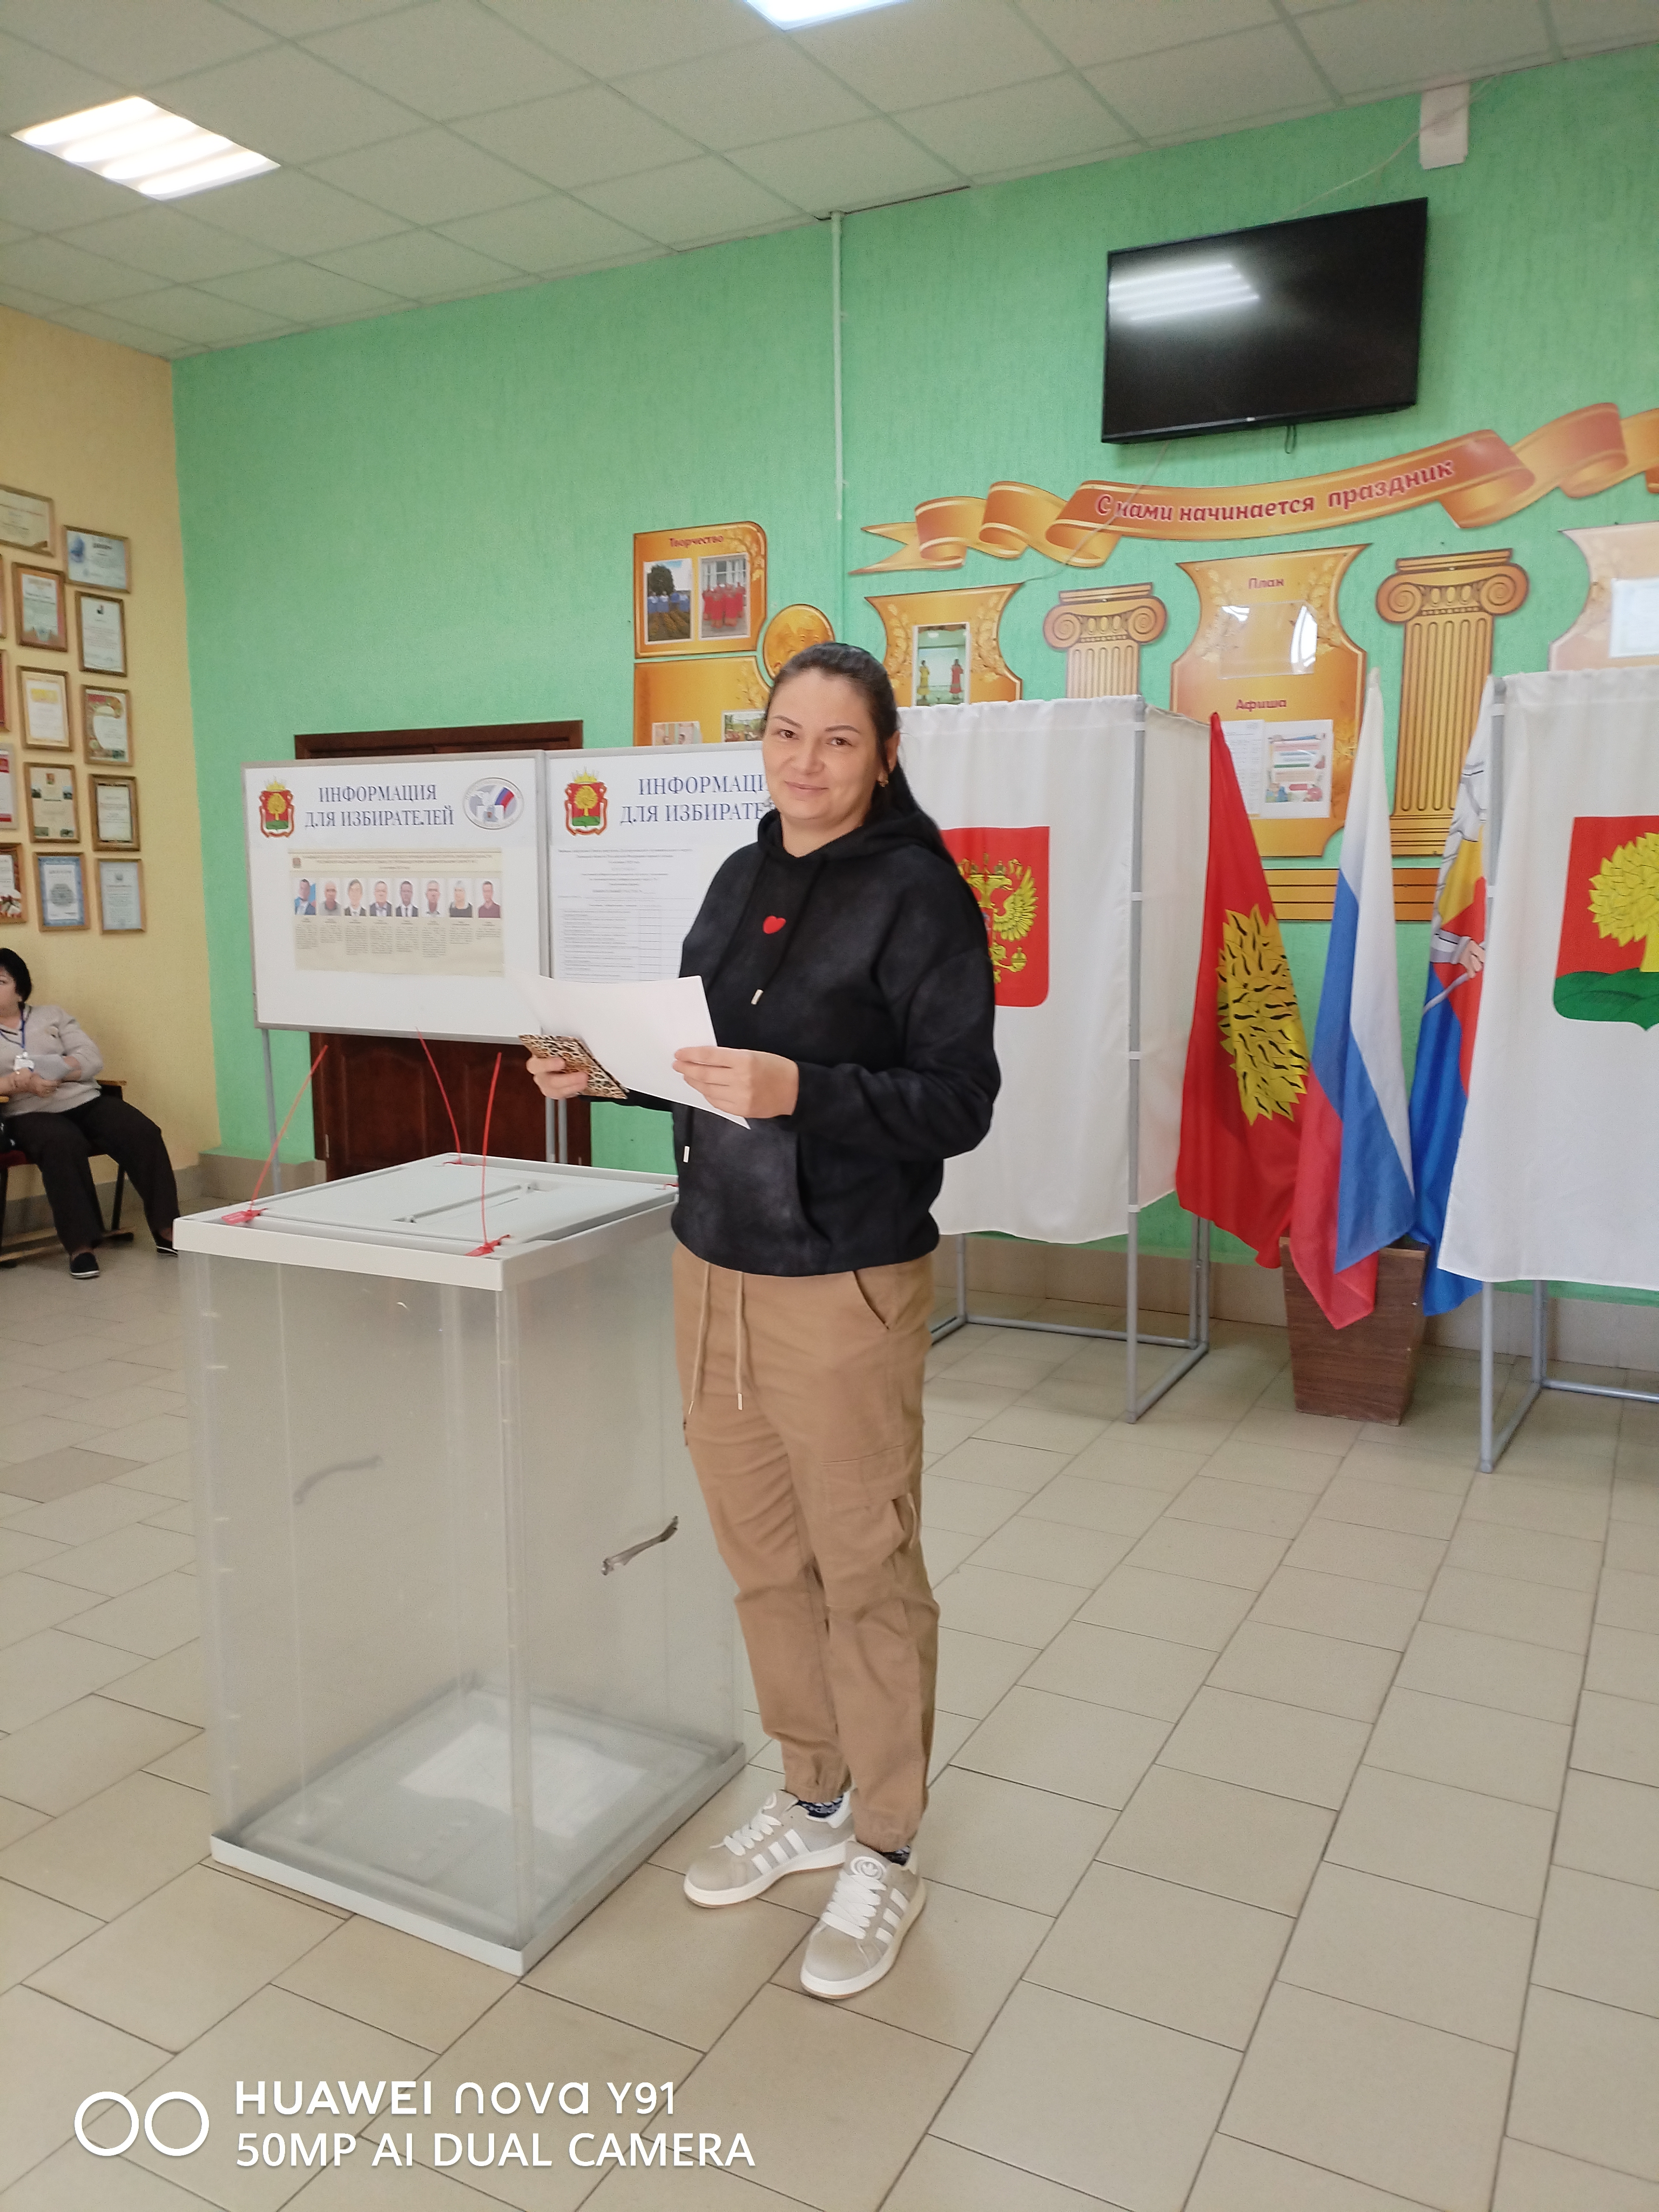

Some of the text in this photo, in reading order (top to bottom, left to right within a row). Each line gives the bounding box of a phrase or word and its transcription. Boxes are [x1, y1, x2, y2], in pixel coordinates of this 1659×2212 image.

[1097, 460, 1453, 522] С нами начинается праздник
[1248, 577, 1284, 590] План
[1235, 699, 1287, 712] Афиша
[318, 785, 437, 802] ИНФОРМАЦИЯ
[305, 805, 455, 828] ДЛЯ ИЗБИРАТЕЛЕЙ
[621, 802, 767, 824] ДЛЯ ИЗБИРАТЕ
